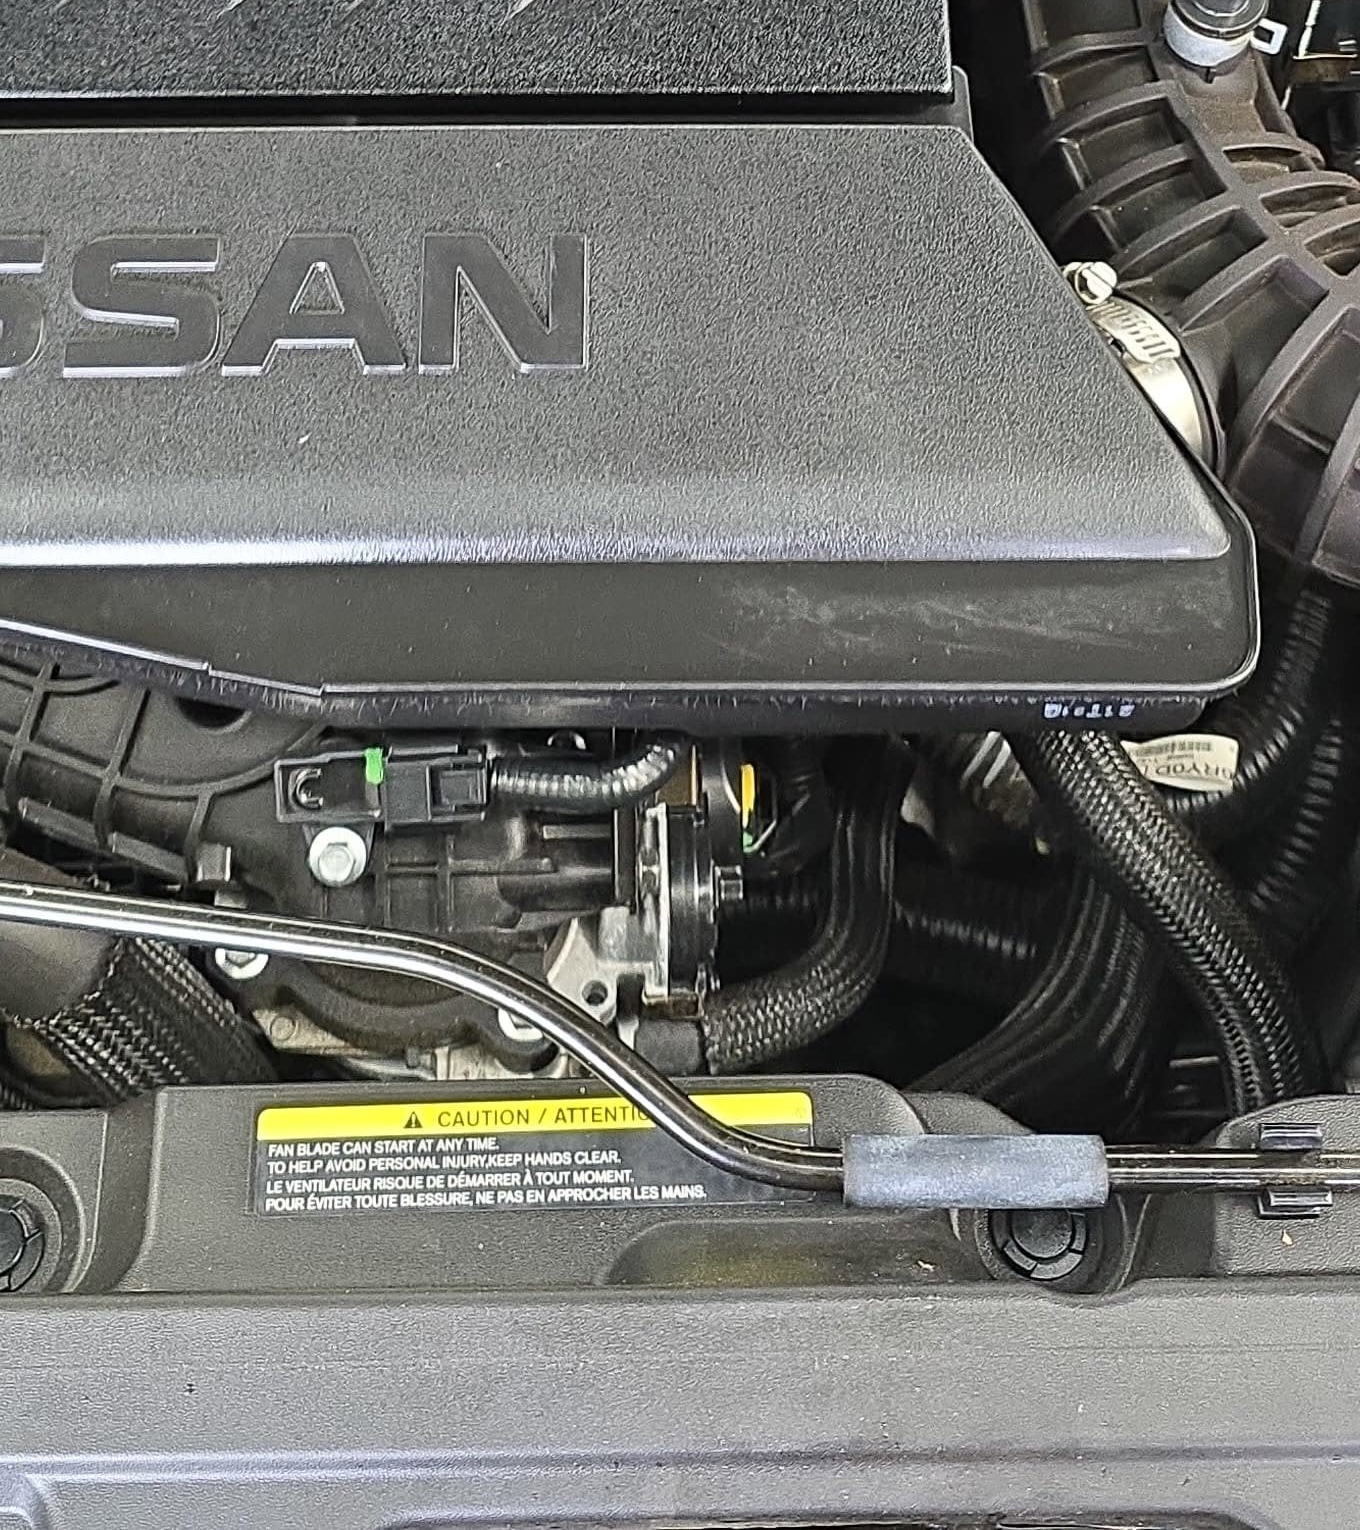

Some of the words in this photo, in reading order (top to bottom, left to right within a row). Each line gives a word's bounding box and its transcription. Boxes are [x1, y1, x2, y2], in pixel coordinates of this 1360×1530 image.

[438, 1108, 529, 1128] CAUTION
[538, 1107, 548, 1124] /
[268, 1144, 294, 1157] FAN
[297, 1142, 340, 1156] BLADE
[343, 1141, 372, 1155] CAN
[374, 1140, 415, 1154] START
[417, 1139, 434, 1153] AT
[436, 1138, 465, 1152] ANY
[465, 1137, 499, 1151] TIME.
[267, 1160, 286, 1174] TO
[289, 1159, 322, 1173] HELP
[325, 1157, 366, 1172] AVOID
[369, 1155, 439, 1171] PERSONAL
[525, 1152, 572, 1166] HANDS
[574, 1151, 621, 1165] CLEAR.
[266, 1180, 282, 1194] LE
[285, 1177, 371, 1193] VENTILATEUR
[373, 1175, 424, 1190] RISQUE
[426, 1174, 445, 1189] DE
[447, 1170, 521, 1188] DÉMARRER
[523, 1168, 534, 1185] À
[536, 1171, 570, 1185] TOUT
[572, 1169, 634, 1184] MOMENT.
[265, 1196, 304, 1211] POUR
[306, 1192, 352, 1209] ÉVITER
[354, 1194, 398, 1208] TOUTE
[400, 1191, 473, 1208] BLESSURE,
[475, 1190, 495, 1204] NE
[497, 1189, 524, 1203] PAS
[526, 1188, 545, 1202] EN
[547, 1186, 632, 1201] APPROCHER
[634, 1185, 658, 1200] LES
[660, 1184, 707, 1199] MAINS.
